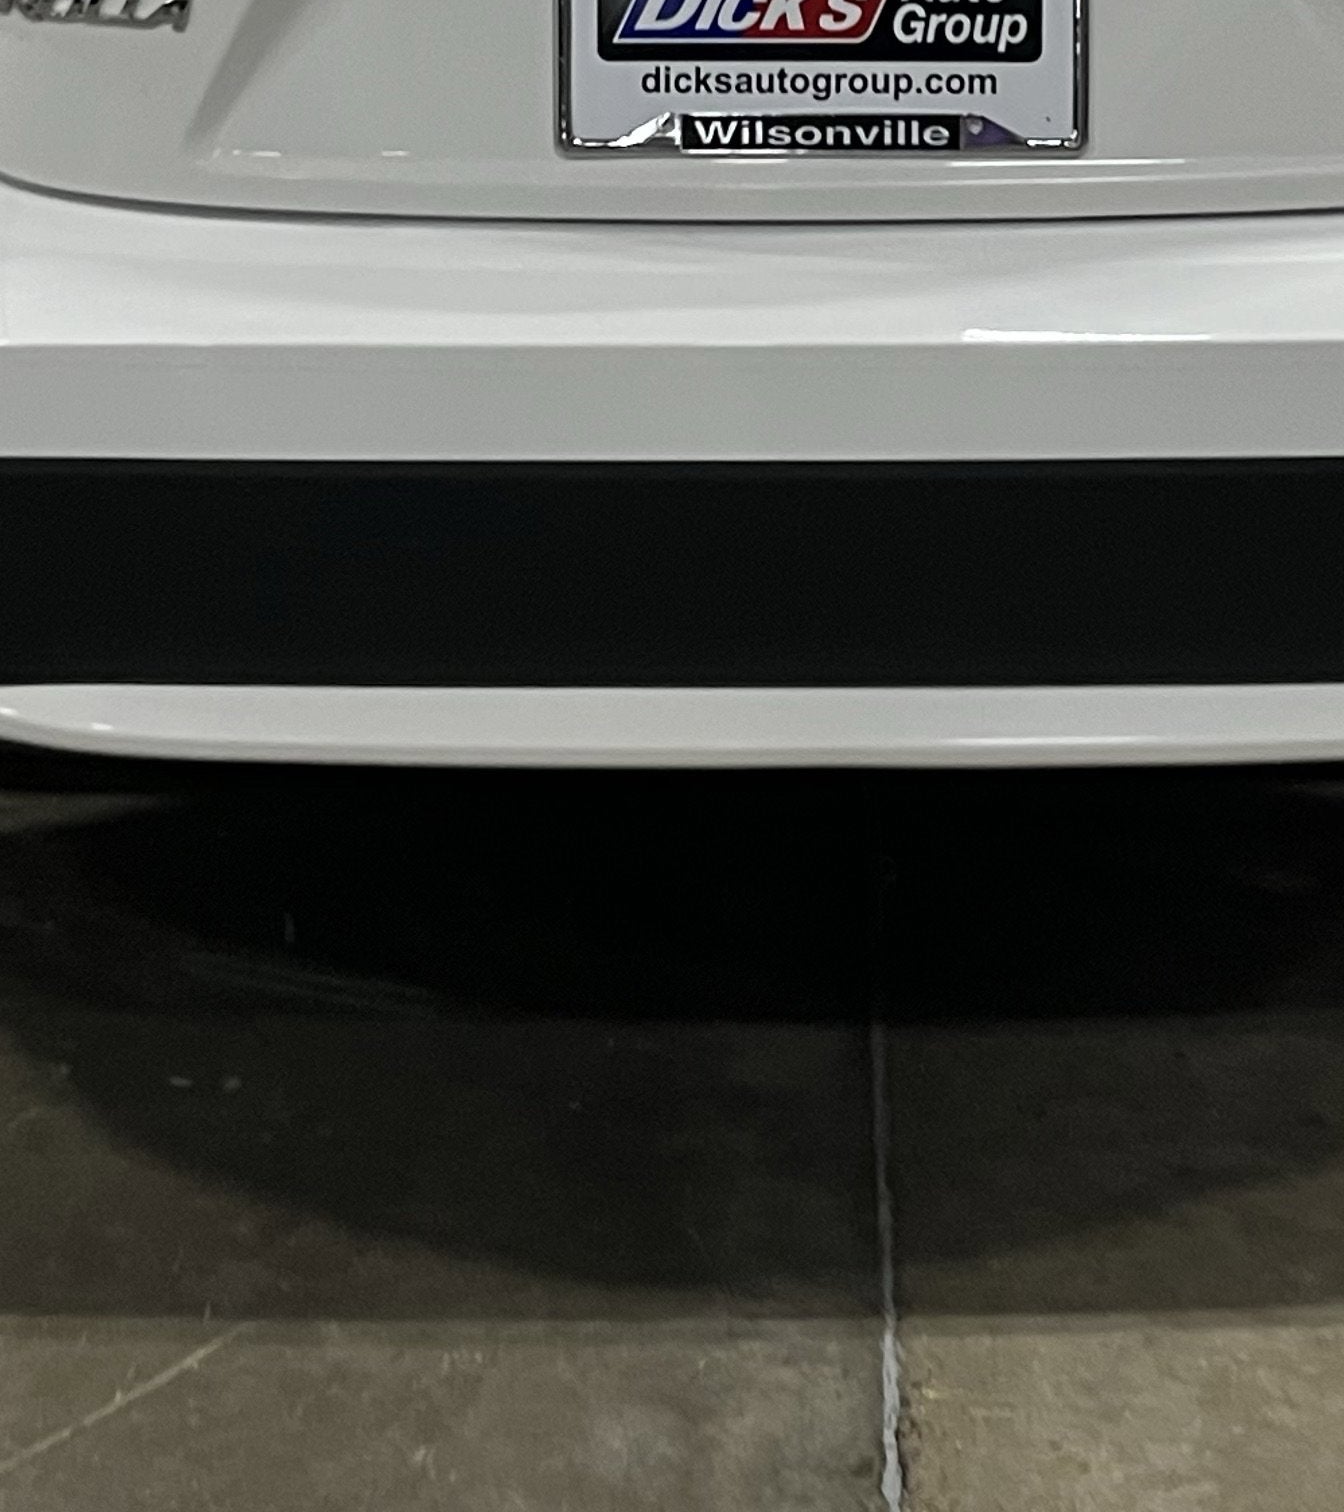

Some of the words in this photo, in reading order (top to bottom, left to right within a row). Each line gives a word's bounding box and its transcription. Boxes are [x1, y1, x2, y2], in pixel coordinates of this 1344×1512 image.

[893, 7, 1028, 53] Group
[641, 66, 997, 101] dicksautogroup.com
[694, 118, 950, 147] Wilsonville
